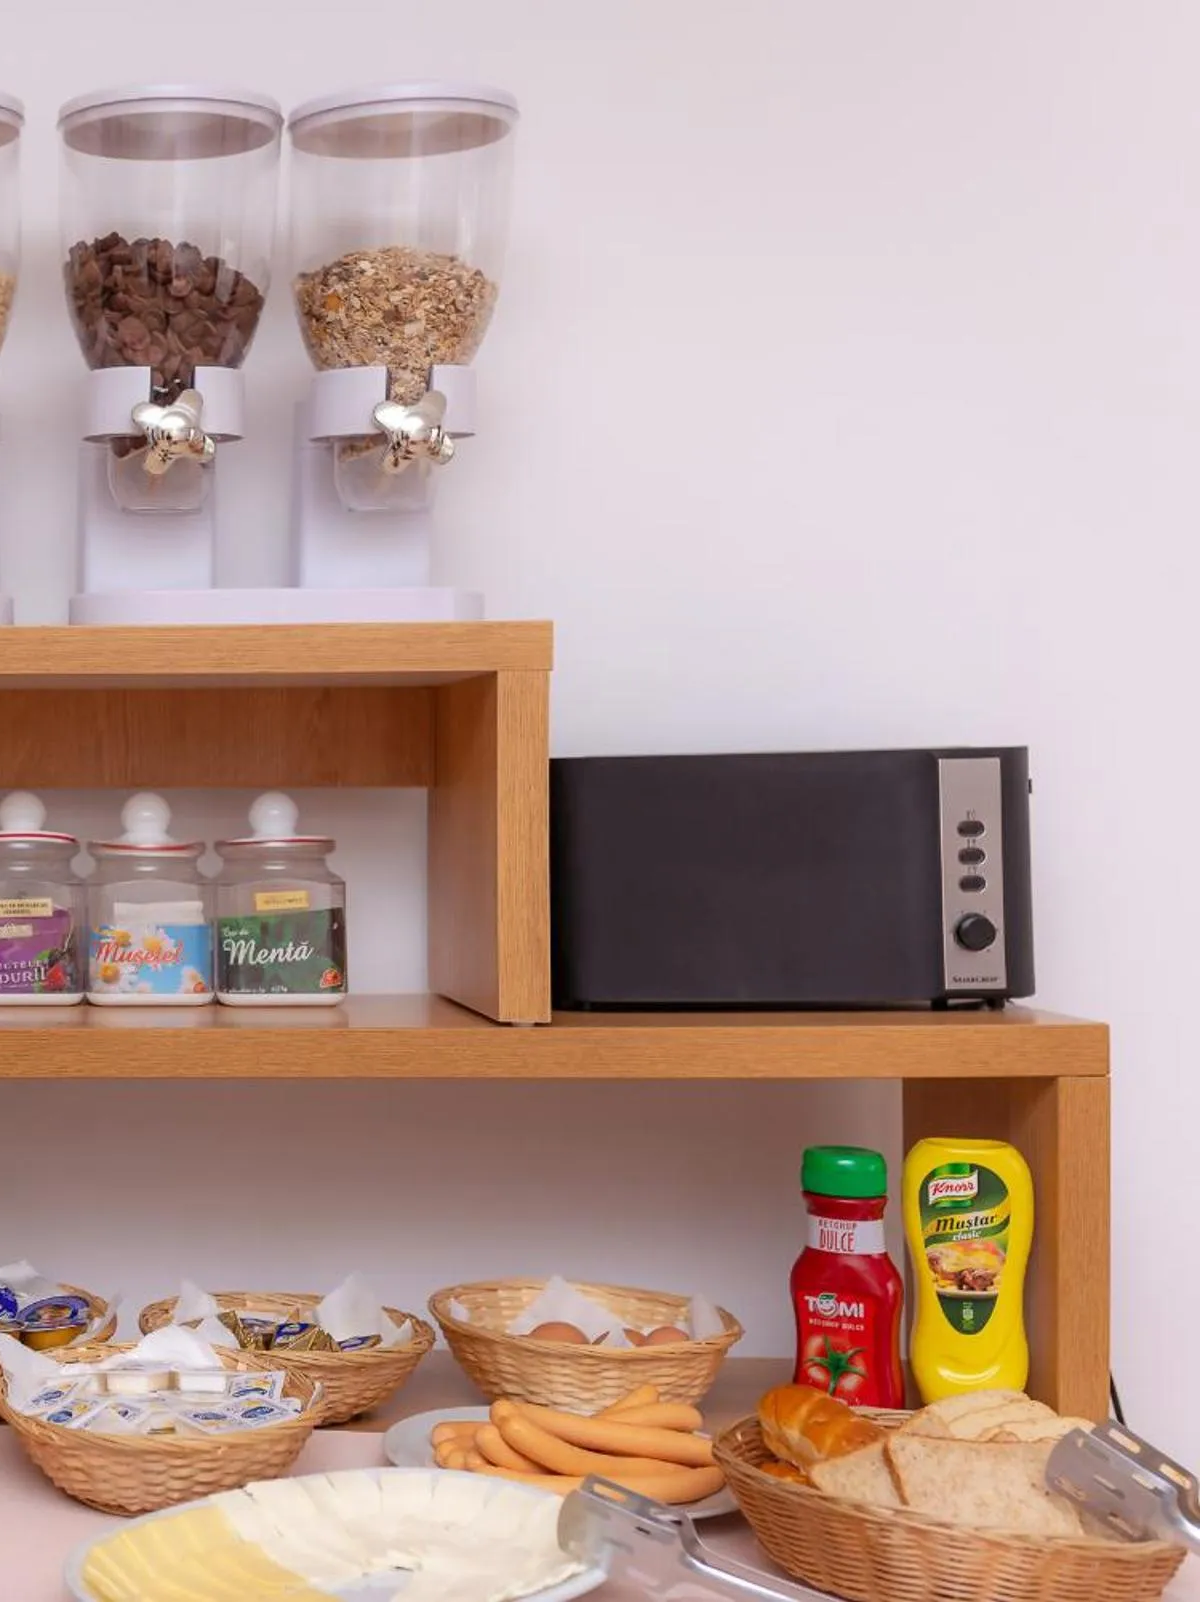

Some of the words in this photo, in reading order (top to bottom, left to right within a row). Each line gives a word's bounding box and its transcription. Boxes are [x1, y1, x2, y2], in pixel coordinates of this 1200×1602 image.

[222, 939, 315, 966] Mentă
[931, 1180, 976, 1196] Knorr
[820, 1228, 856, 1252] DULCE
[803, 1292, 865, 1319] TOMI
